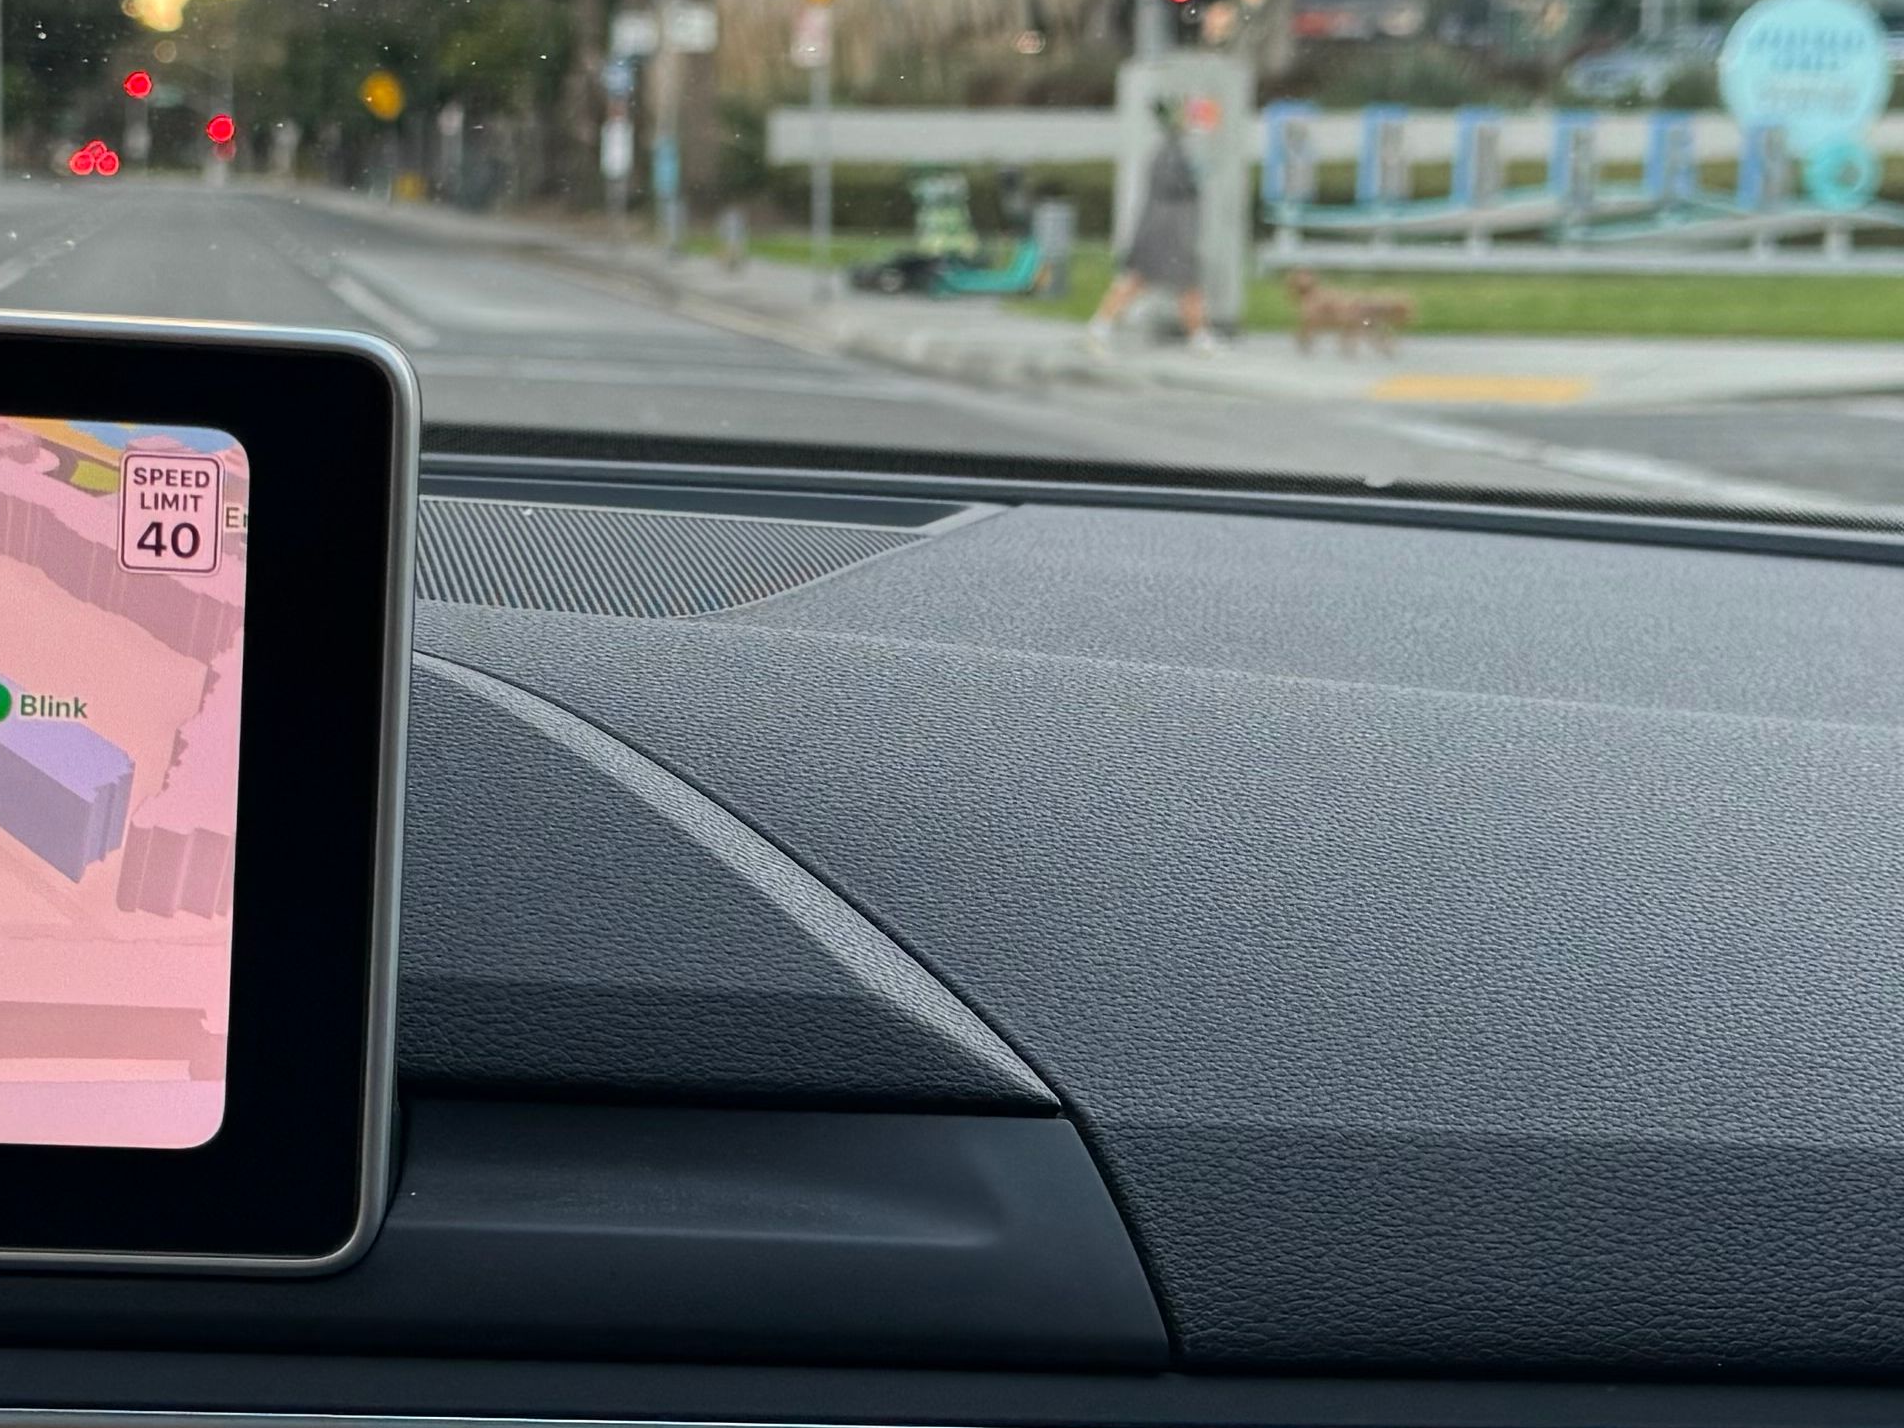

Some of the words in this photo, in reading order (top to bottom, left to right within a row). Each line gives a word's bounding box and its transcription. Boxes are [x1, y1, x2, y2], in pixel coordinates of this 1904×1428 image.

[132, 467, 210, 489] SPEED
[140, 491, 202, 512] LIMIT
[136, 522, 201, 560] 40
[20, 695, 88, 721] Blink
